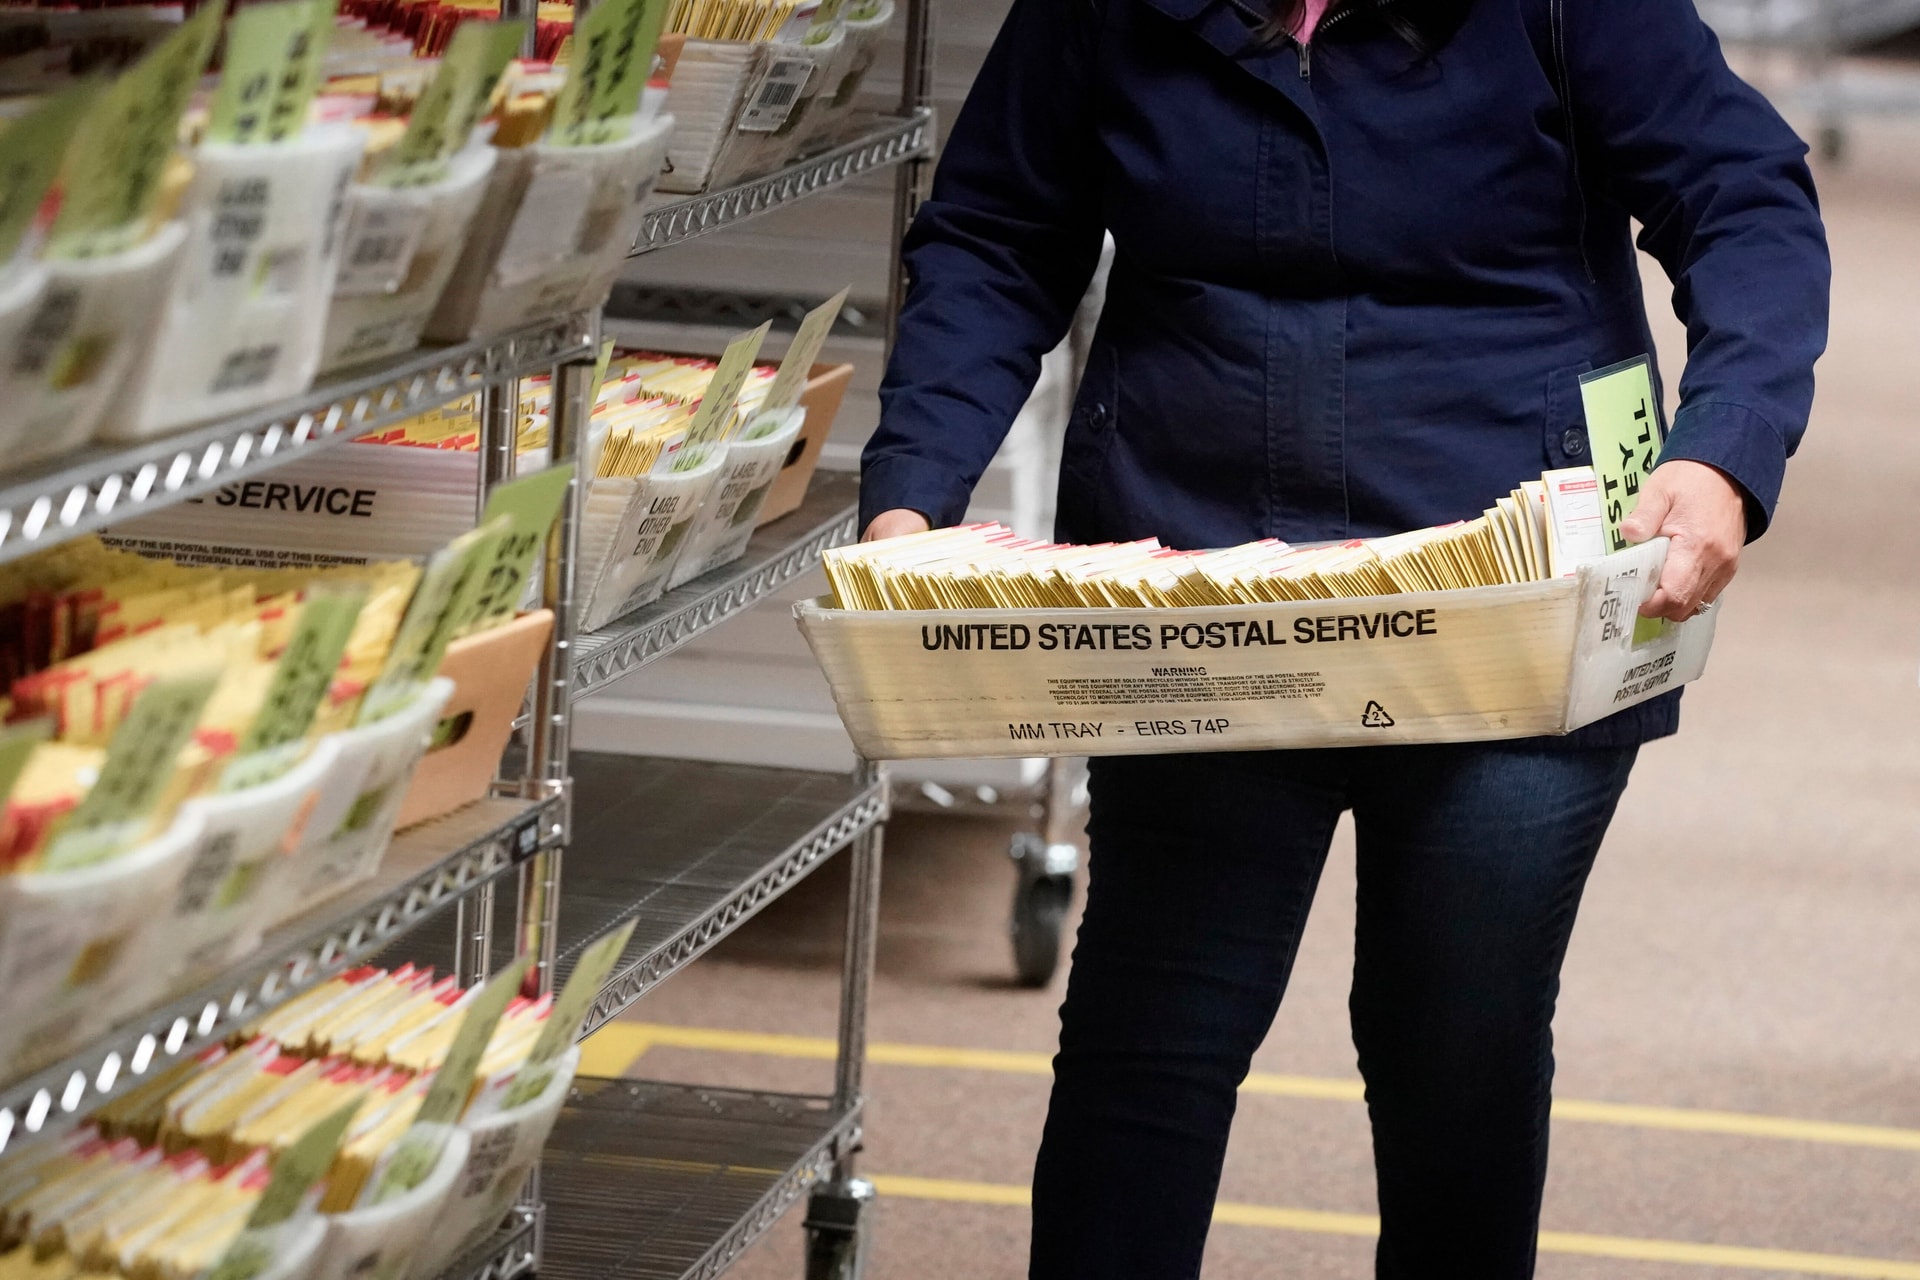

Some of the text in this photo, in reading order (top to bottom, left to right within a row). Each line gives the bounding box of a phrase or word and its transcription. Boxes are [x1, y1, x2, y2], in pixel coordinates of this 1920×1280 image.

[1634, 398, 1653, 475] ALL
[215, 482, 376, 517] SERVICE
[649, 496, 680, 515] LABEL
[1602, 474, 1626, 552] EST
[638, 514, 672, 536] OTHER
[124, 538, 138, 547] OF
[140, 540, 158, 550] THE
[159, 542, 173, 550] US
[174, 543, 210, 554] POSTAL
[256, 549, 274, 558] USE
[276, 551, 290, 560] OF
[290, 552, 312, 561] THIS
[314, 554, 368, 566] EQUIPMENT
[632, 537, 656, 556] END
[176, 553, 189, 562] BY
[190, 554, 234, 565] FEDERAL
[259, 560, 277, 568] THE
[921, 608, 1438, 650] UNITED STATES POSTAL SERVICE
[1151, 667, 1208, 676] WARNING
[1622, 662, 1652, 684] UNITED
[1372, 712, 1380, 721] 2
[1008, 723, 1044, 740] MM
[1049, 722, 1103, 738] TRAY
[1134, 720, 1186, 736] EIRS
[1191, 718, 1230, 734] 74P
